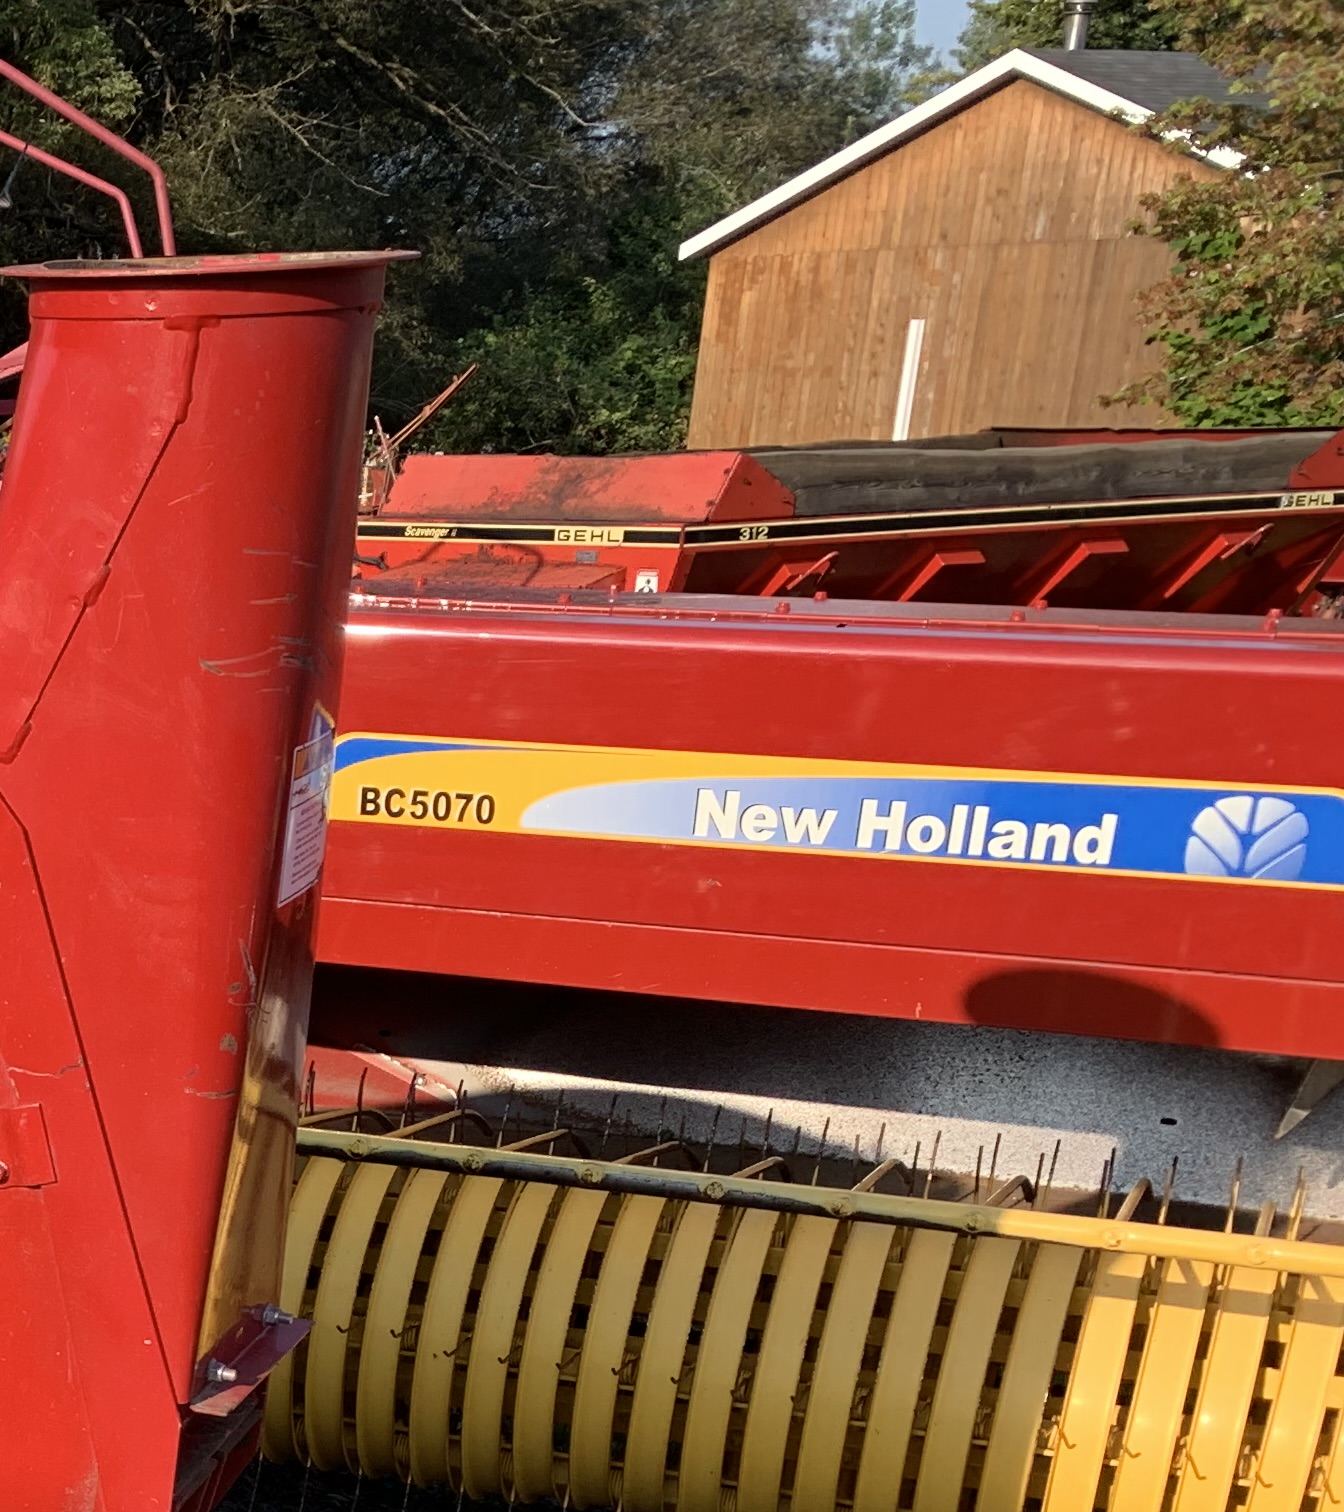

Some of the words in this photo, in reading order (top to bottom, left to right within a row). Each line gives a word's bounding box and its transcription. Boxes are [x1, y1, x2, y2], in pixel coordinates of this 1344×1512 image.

[403, 525, 450, 539] Scavenger
[557, 528, 621, 543] GEHL
[739, 526, 769, 541] 312
[360, 786, 496, 824] BC5070
[694, 789, 838, 844] New
[856, 800, 1118, 865] Holland
